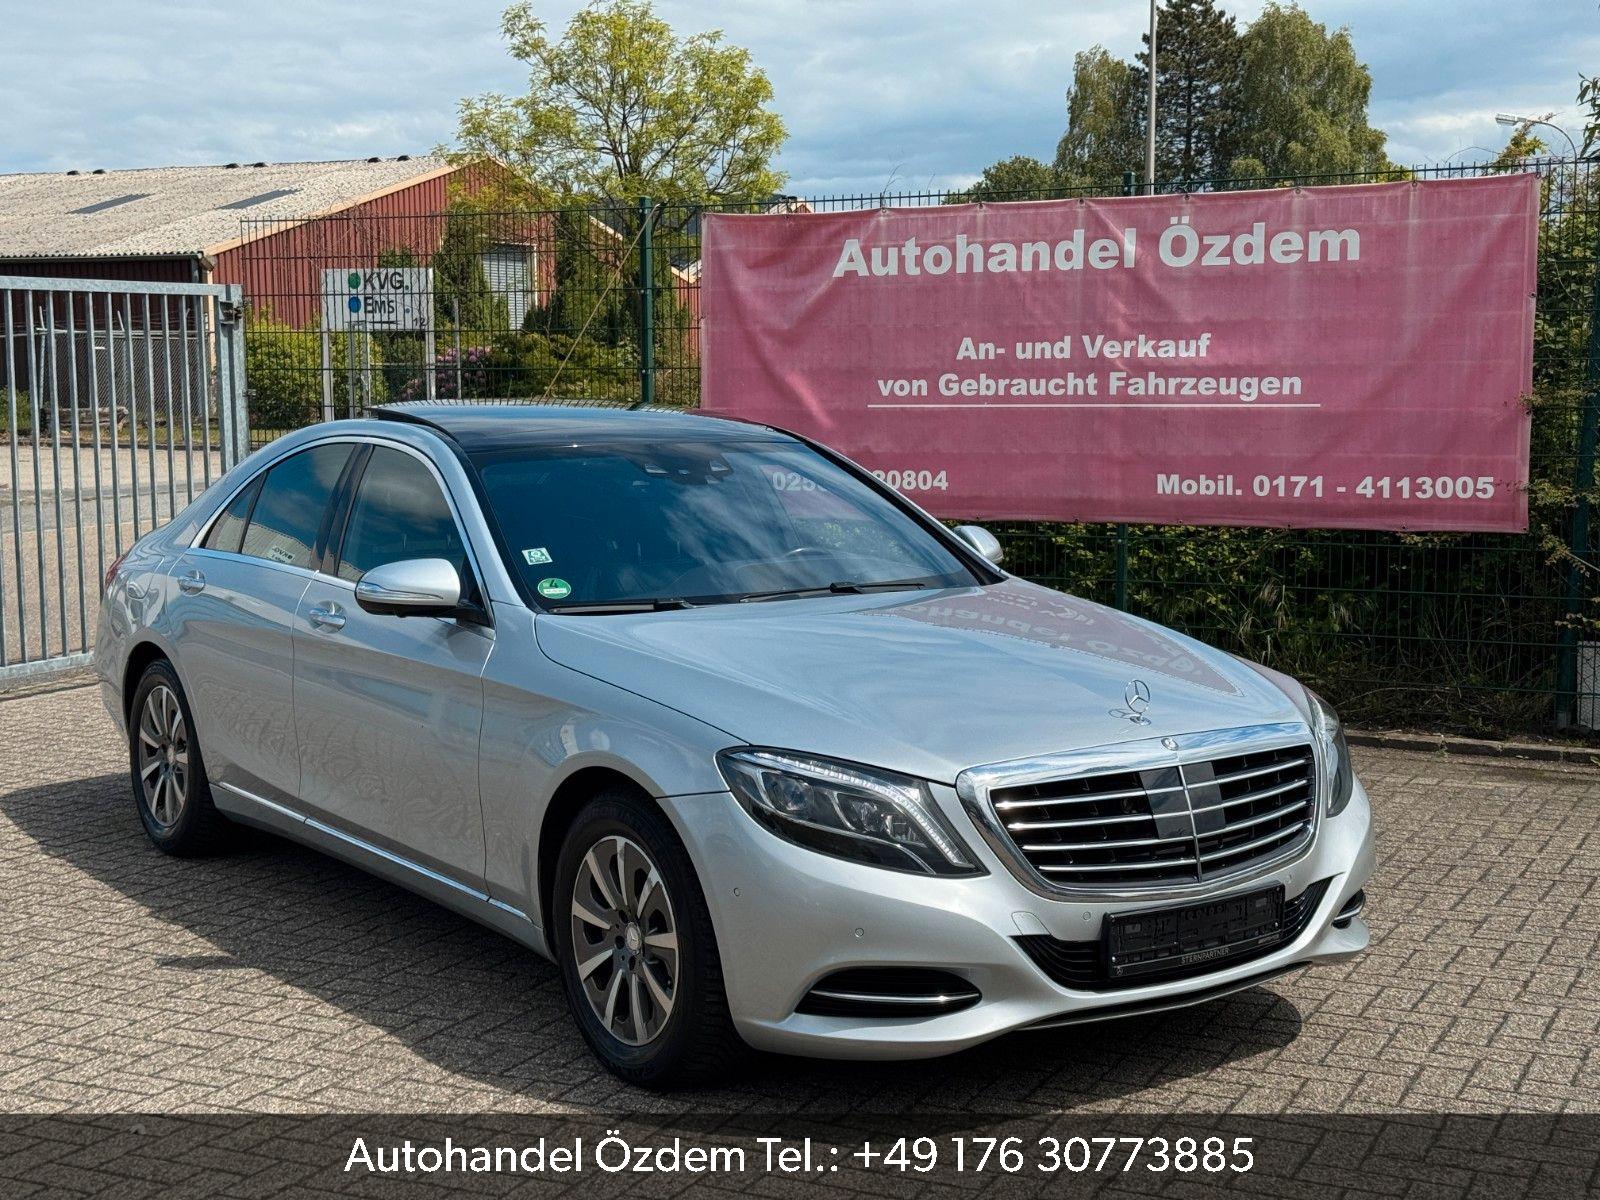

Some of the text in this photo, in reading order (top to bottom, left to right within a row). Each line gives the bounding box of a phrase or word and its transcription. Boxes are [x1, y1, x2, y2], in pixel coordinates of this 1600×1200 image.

[833, 216, 1361, 278] Autohandel Özdem
[955, 333, 1212, 361] An- und Verkauf
[877, 371, 1302, 402] von Gebraucht Fahrzeugen
[1156, 473, 1243, 497] Mobil.
[1253, 474, 1324, 498] 0171
[1355, 475, 1495, 499] 4113005
